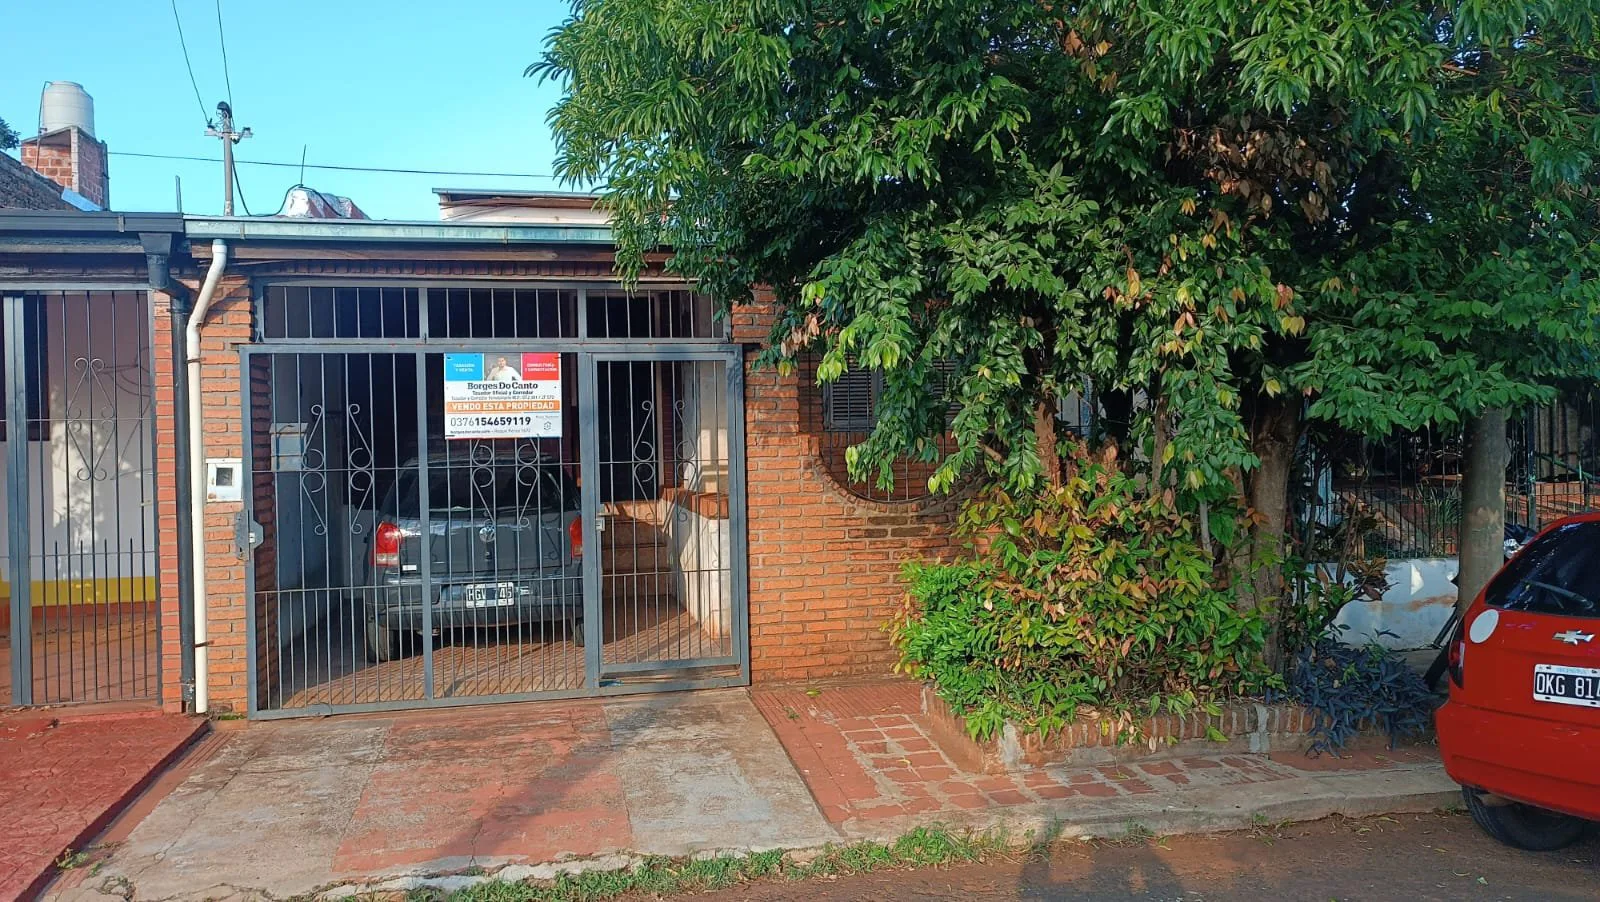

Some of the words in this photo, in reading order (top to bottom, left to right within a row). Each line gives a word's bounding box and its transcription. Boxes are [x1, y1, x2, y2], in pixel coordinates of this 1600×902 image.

[499, 382, 511, 390] Do
[451, 403, 481, 411] VENDO
[482, 402, 505, 410] ESTA
[506, 401, 555, 410] PROPIEDAD
[450, 416, 532, 427] 0376154659119
[1536, 673, 1566, 695] OKG
